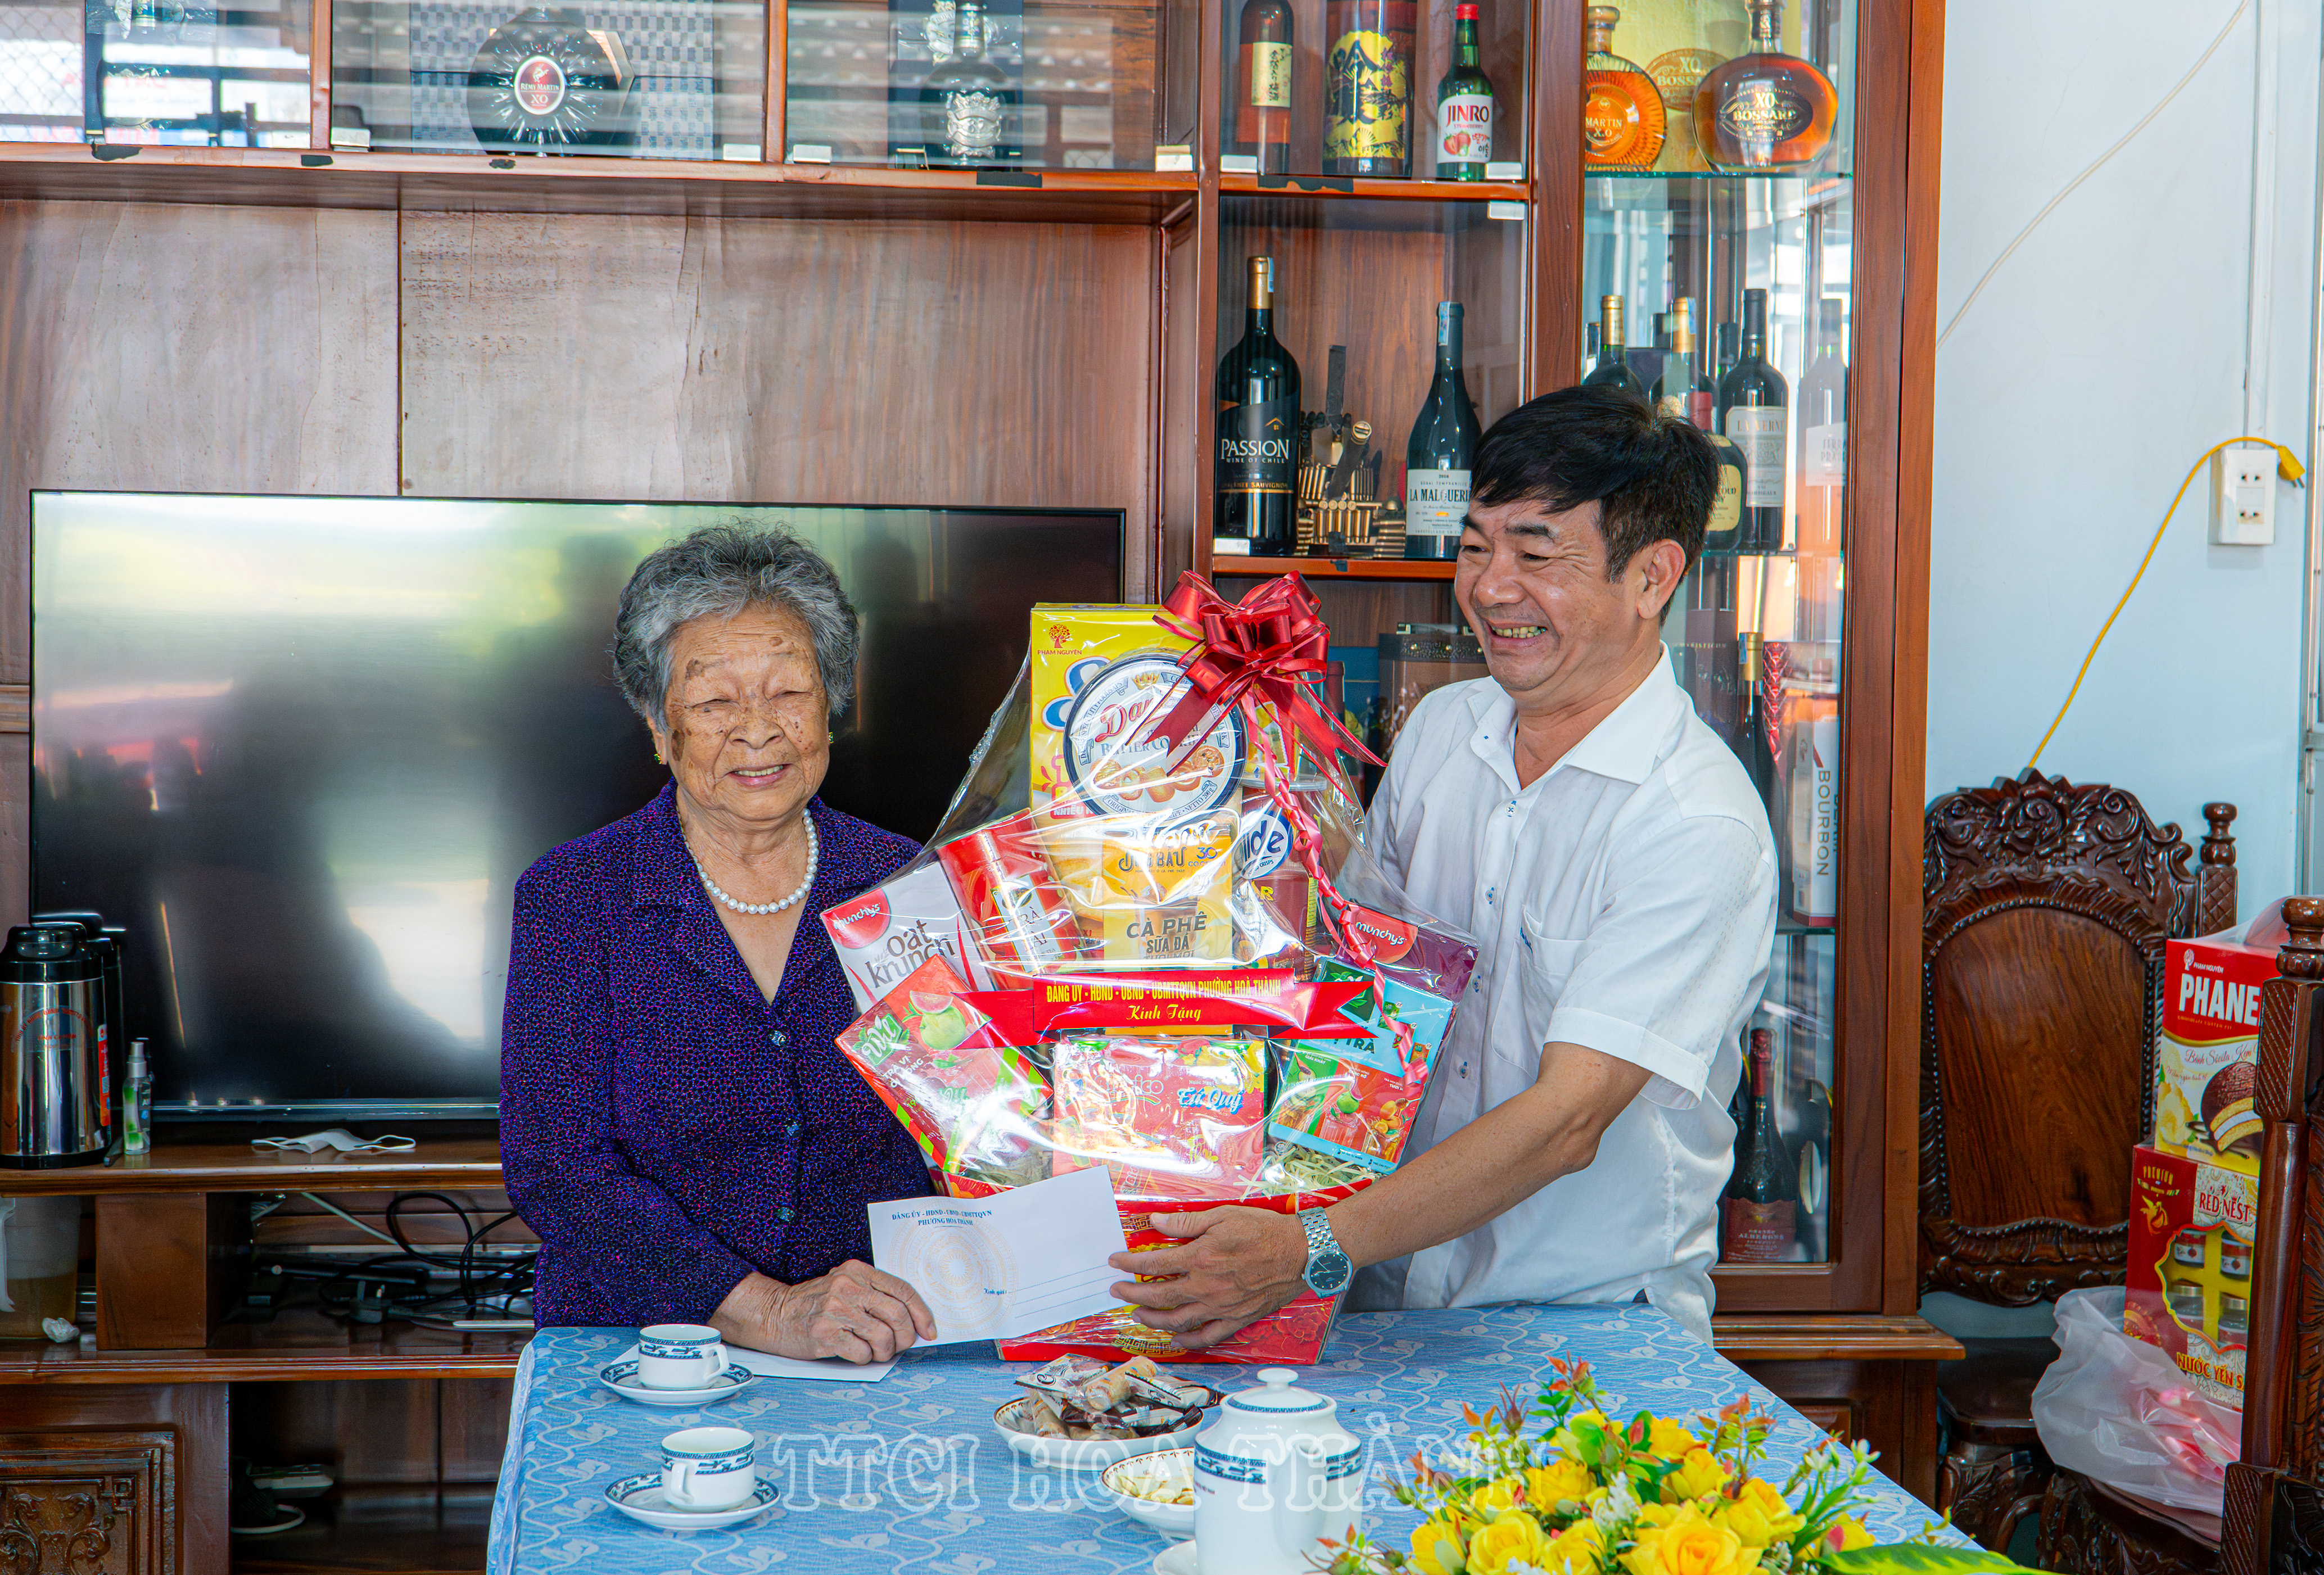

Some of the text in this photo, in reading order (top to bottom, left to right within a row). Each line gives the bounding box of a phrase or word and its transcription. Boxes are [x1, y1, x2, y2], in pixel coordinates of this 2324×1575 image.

[1658, 75, 1703, 86] BOSSA
[530, 94, 549, 104] XO
[1755, 92, 1775, 108] XO
[1446, 105, 1489, 128] JINRO
[1220, 438, 1290, 460] PASSION
[1410, 488, 1470, 504] LA MALQUERI
[1816, 770, 1831, 876] BOURBON
[1259, 859, 1274, 868] CRISPS
[1126, 911, 1208, 938] CÀ PHÊ
[1355, 921, 1405, 945] munchy's
[887, 919, 932, 957] oat
[1146, 932, 1190, 954] SỮA ĐÁ
[1090, 984, 1113, 1001] HĐND
[1121, 985, 1144, 1001] UBND
[1198, 976, 1232, 998] PHƯỜNG
[1254, 975, 1281, 997] THÀNH
[2178, 972, 2260, 1026] PHANE
[1166, 1003, 1202, 1022] Tặng
[892, 1211, 910, 1221] ĐẢNG
[2199, 1192, 2250, 1223] RED NEST
[917, 1217, 946, 1226] PHƯỜNG
[2176, 1351, 2212, 1379] NƯỚC
[2213, 1363, 2234, 1388] YẾN
